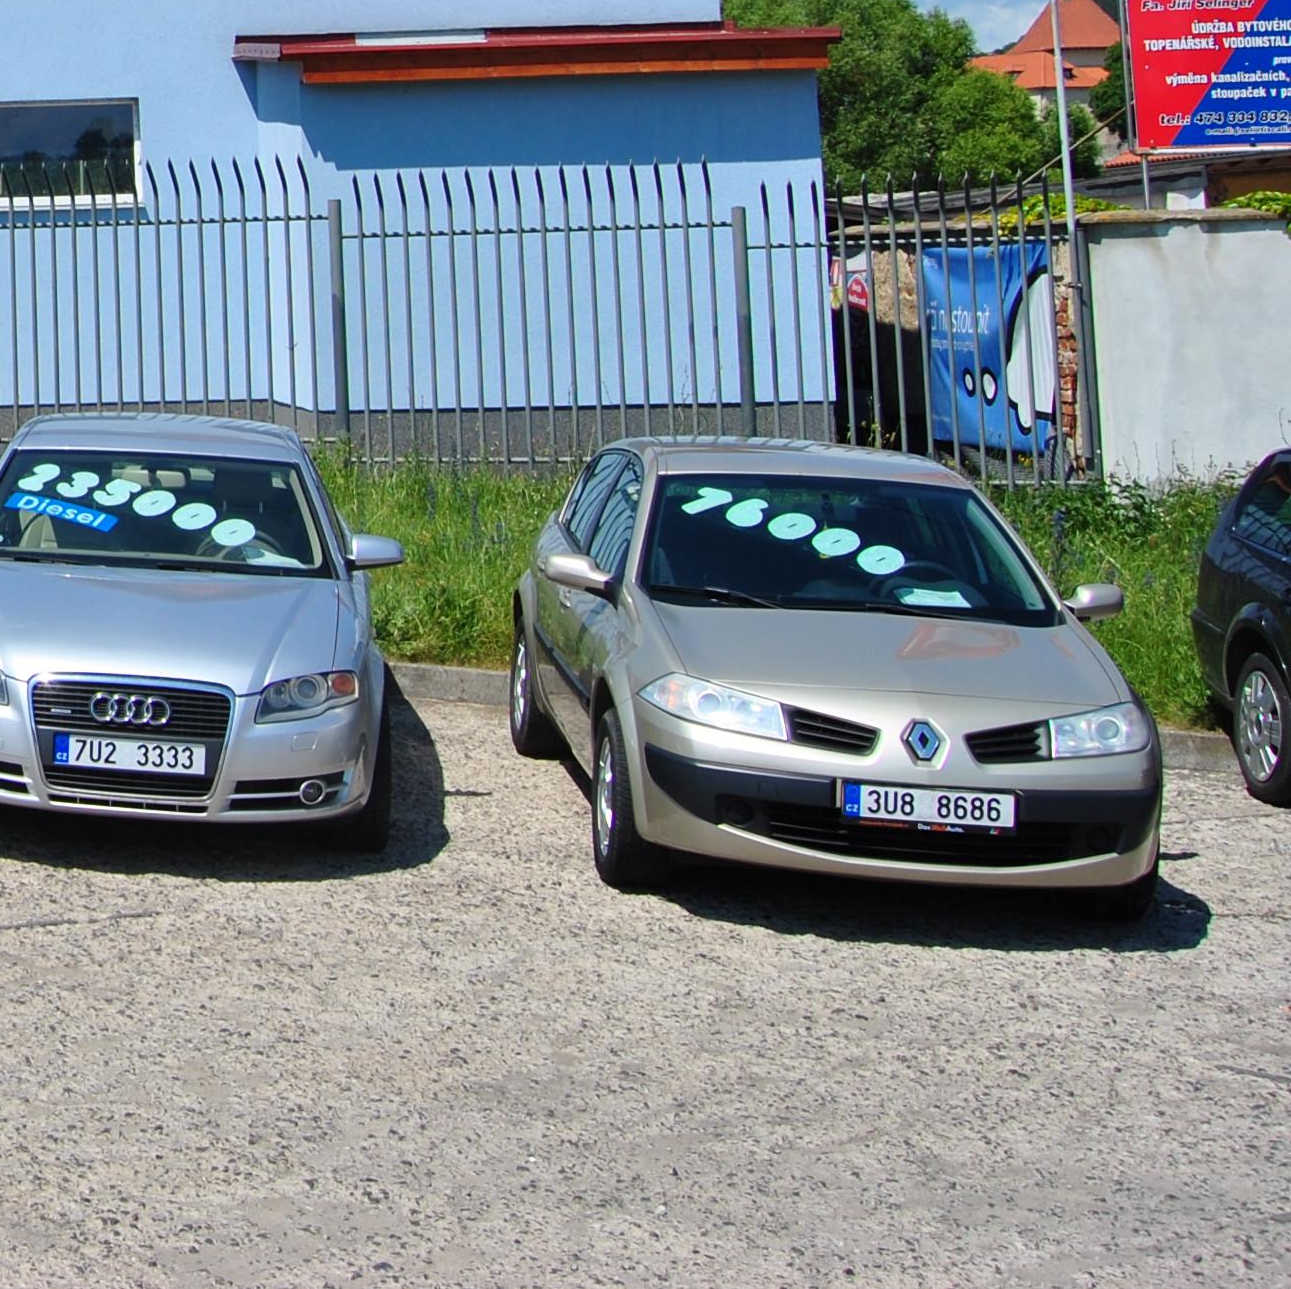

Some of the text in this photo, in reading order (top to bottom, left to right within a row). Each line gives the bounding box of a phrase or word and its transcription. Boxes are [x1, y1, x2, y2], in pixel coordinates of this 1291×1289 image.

[1141, 0, 1164, 12] Fa.
[1191, 19, 1234, 34] ÚDRŽBA
[1143, 38, 1219, 52] TOPENÁŘSKÉ,
[1165, 72, 1207, 86] výměna
[1211, 86, 1266, 100] stoupaček
[1159, 113, 1192, 126] tel.:
[1194, 111, 1224, 125] 474
[1227, 110, 1256, 124] 334
[17, 463, 256, 547] 235000
[18, 494, 108, 530] Diesel
[56, 739, 194, 770] CZ 7U2 3333
[845, 789, 1001, 822] CZ 3U8 8686
